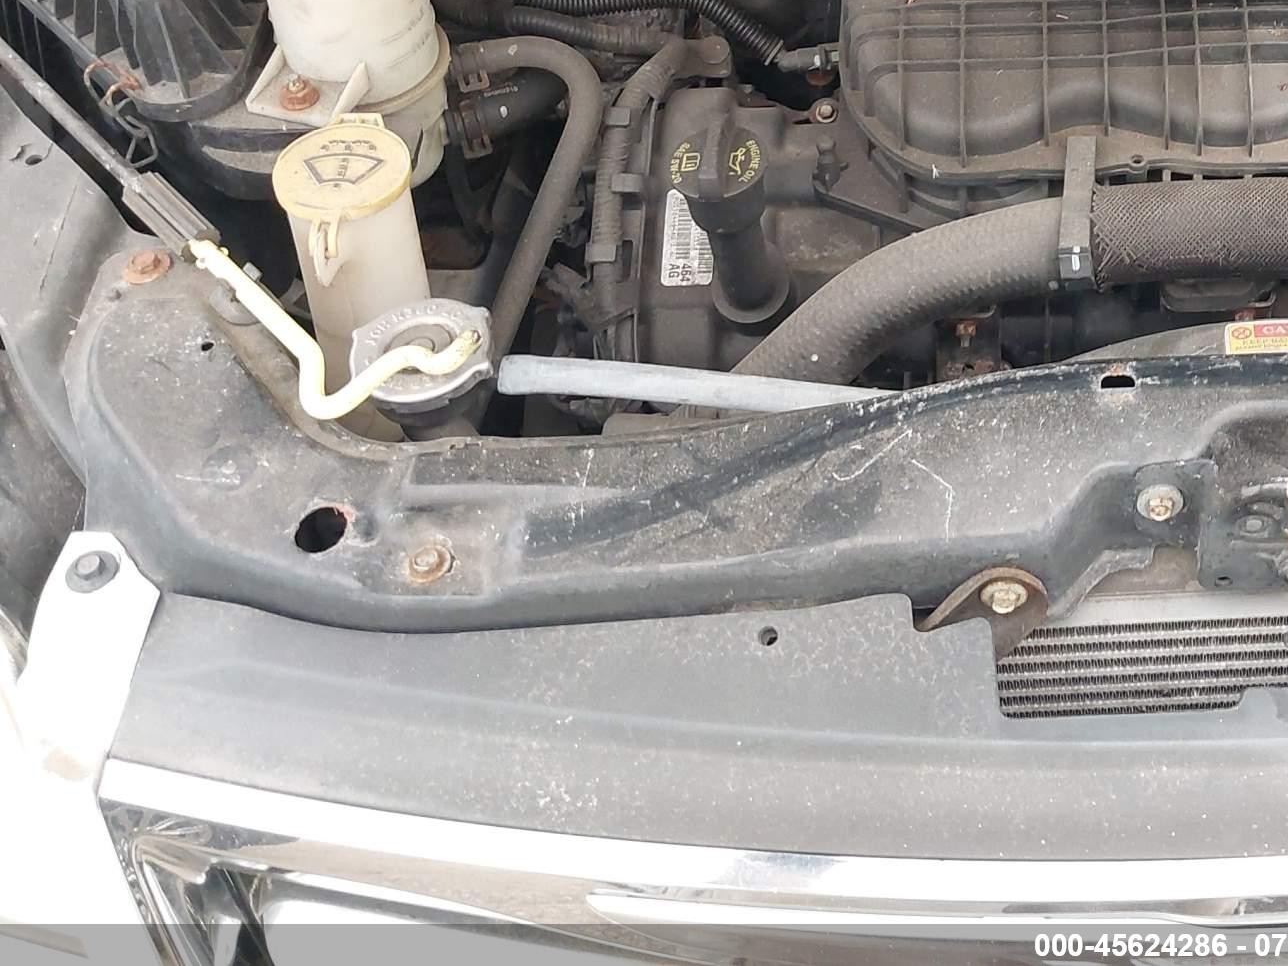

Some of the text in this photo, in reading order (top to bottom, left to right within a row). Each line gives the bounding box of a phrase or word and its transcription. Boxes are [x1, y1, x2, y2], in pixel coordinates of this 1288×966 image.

[674, 142, 691, 158] SAE
[738, 139, 761, 183] ENGINE OIL
[668, 263, 680, 279] AG
[681, 263, 692, 283] 464
